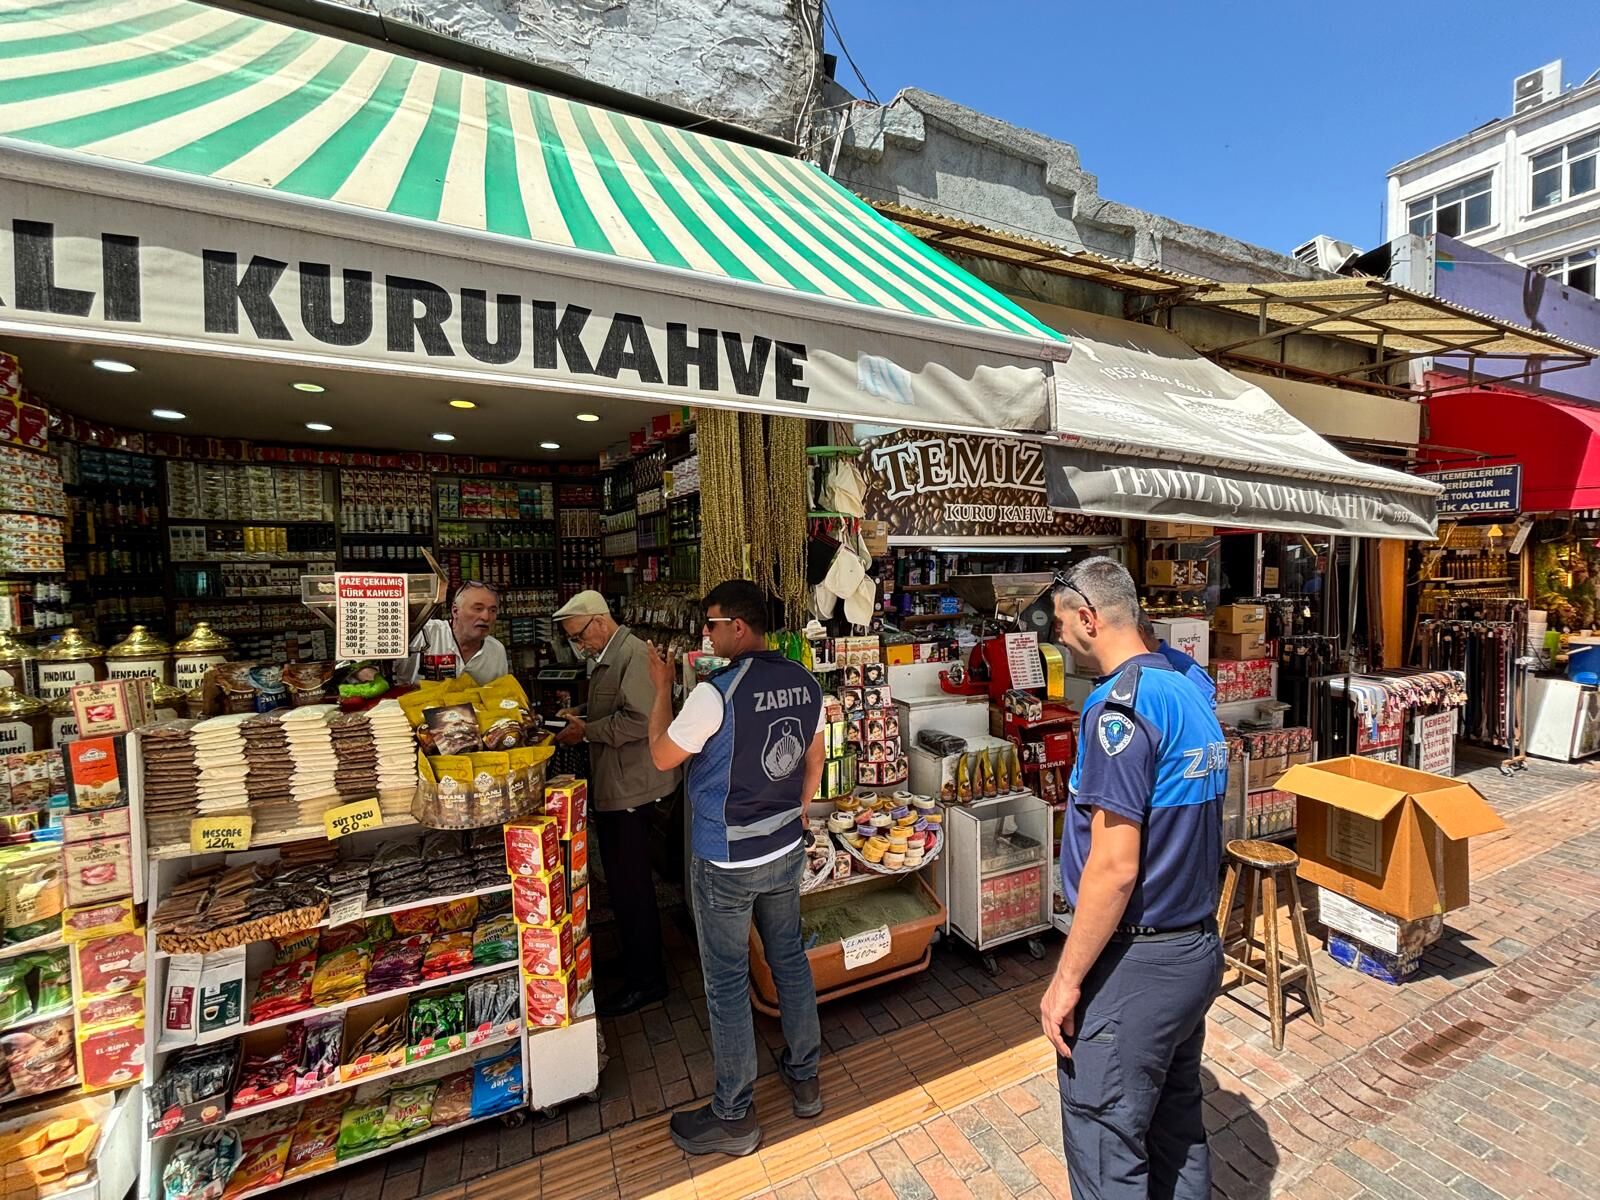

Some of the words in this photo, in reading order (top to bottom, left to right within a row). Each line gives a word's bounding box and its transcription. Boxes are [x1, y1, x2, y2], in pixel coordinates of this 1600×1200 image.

[0, 219, 140, 322] LI
[202, 249, 809, 404] KURUKAHVE
[1442, 467, 1513, 480] KEMERLERİMİZ
[1441, 479, 1494, 490] ERİDEDİR
[1451, 491, 1474, 500] TOKA
[1475, 488, 1510, 499] TAKILIR
[1246, 481, 1385, 522] KURUKAHVE
[1460, 501, 1510, 510] AÇILIR
[945, 504, 996, 522] KURU
[340, 577, 360, 585] TAZE
[363, 577, 403, 587] ÇEKİLMİŞ
[341, 588, 364, 597] TÜRK
[366, 588, 402, 597] KAHVESİ
[43, 669, 76, 682] FINDIKLI
[177, 664, 197, 674] DAMLA
[178, 677, 192, 689] TÜRK
[79, 692, 118, 703] CHAMPION
[753, 685, 812, 713] ZABITA
[332, 816, 348, 829] SÜT
[350, 809, 374, 822] TOZU
[340, 821, 360, 835] 60
[74, 850, 121, 863] CHAMPION
